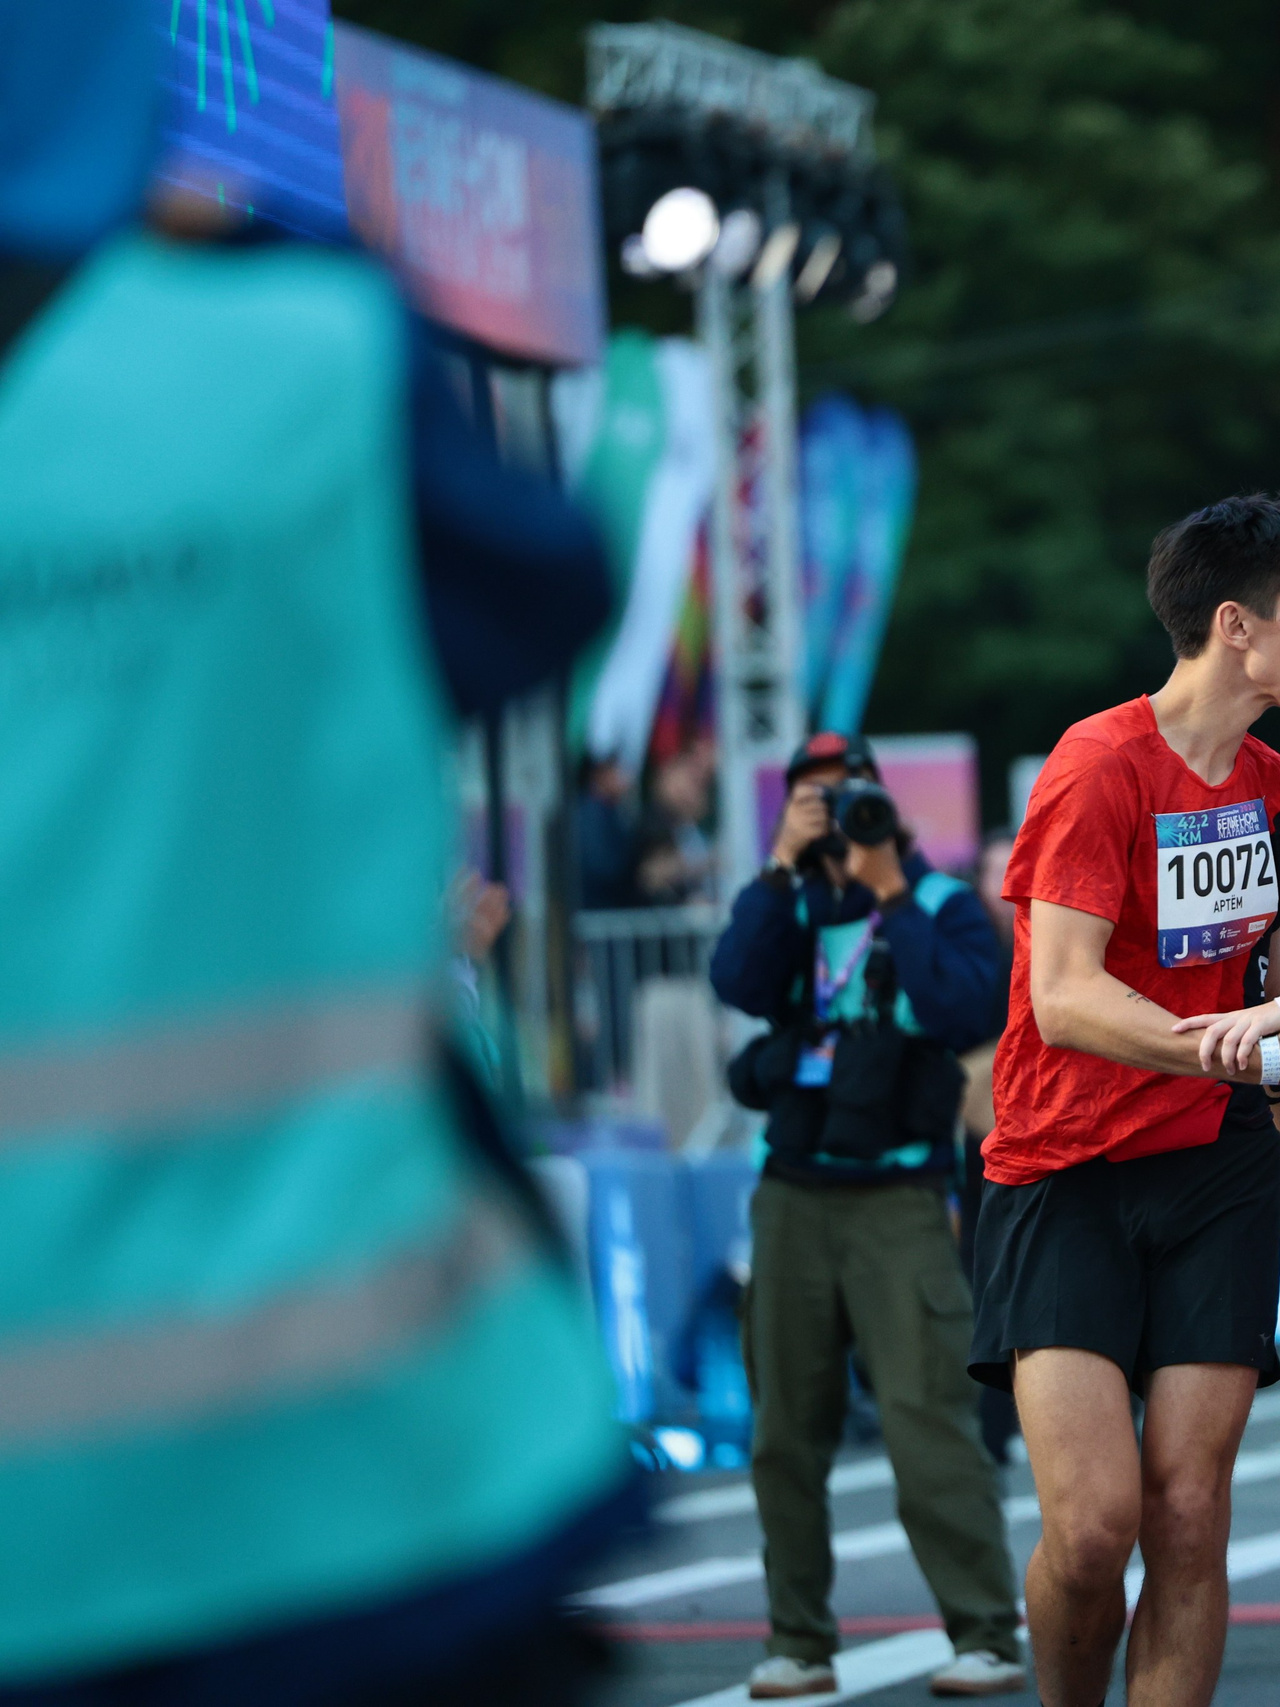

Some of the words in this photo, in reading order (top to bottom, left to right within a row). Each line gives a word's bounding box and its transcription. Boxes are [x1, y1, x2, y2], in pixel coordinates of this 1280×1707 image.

[1177, 813, 1209, 830] 42,2
[1168, 840, 1274, 900] 10072
[1213, 895, 1243, 914] АРТЁМ
[1174, 934, 1189, 960] J
